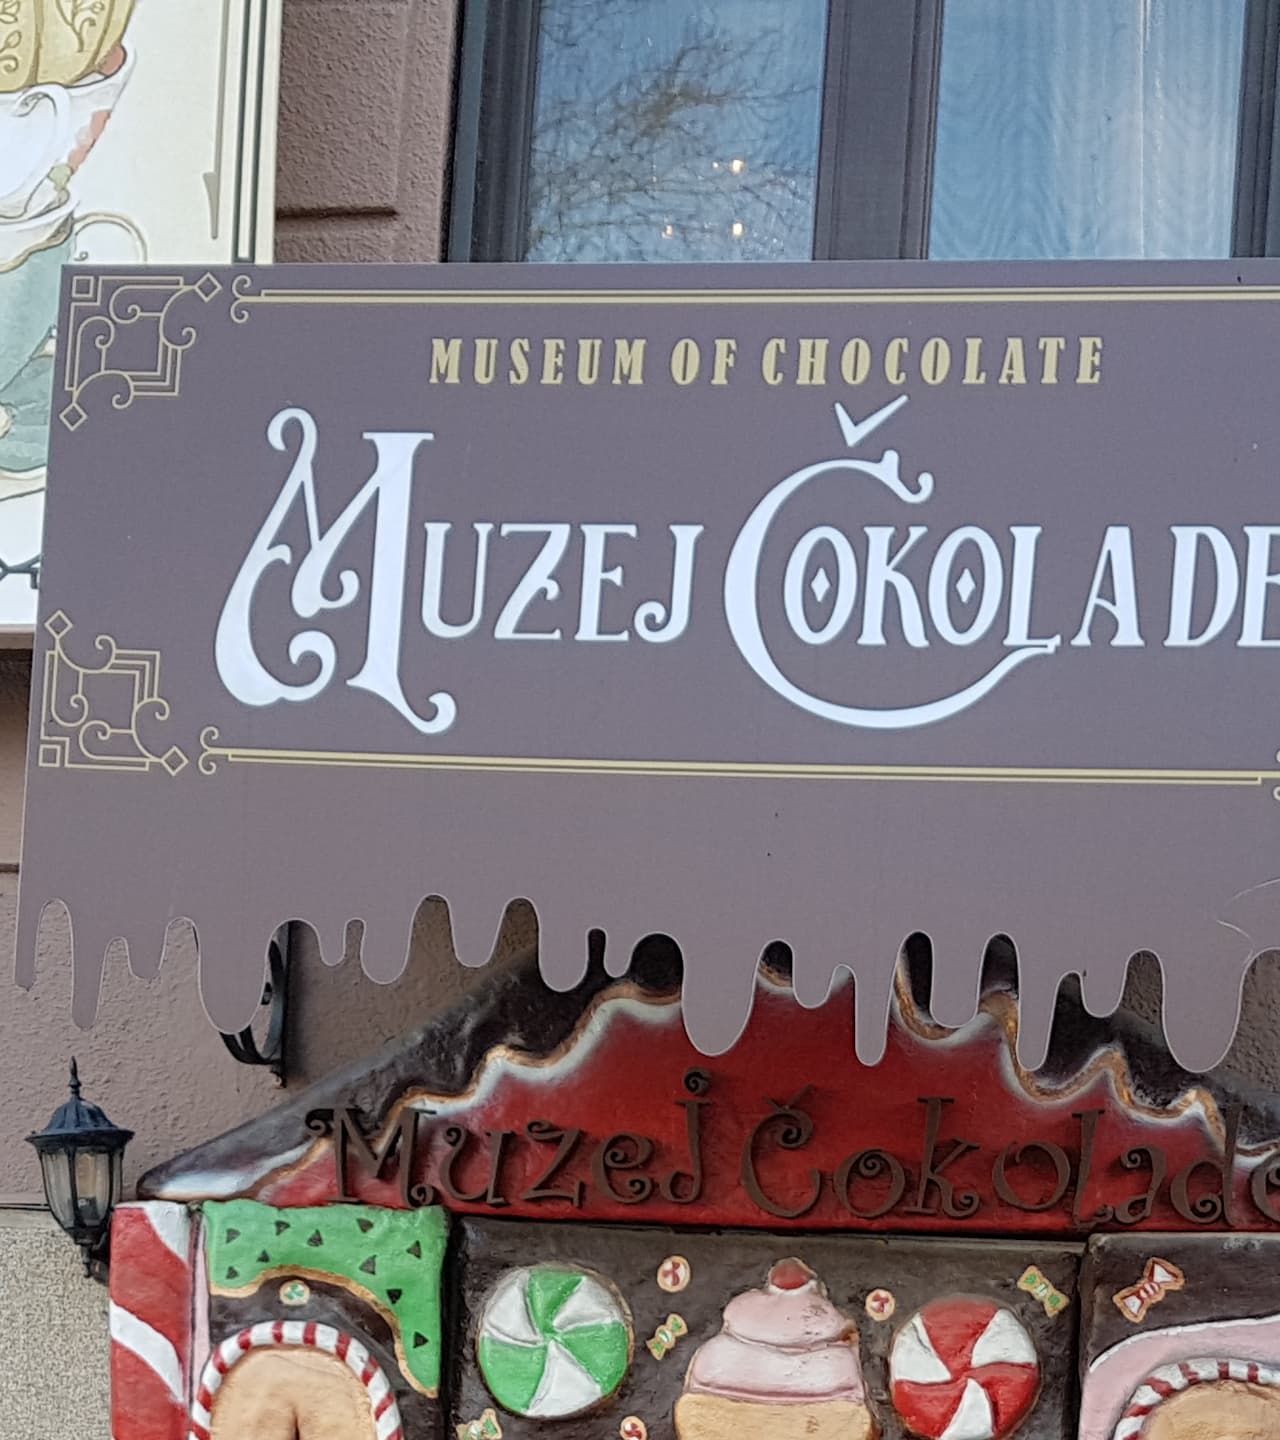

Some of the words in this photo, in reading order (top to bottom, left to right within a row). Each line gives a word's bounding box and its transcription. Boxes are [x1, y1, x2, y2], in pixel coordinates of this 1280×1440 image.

[429, 338, 644, 384] MUSEUM
[669, 338, 737, 385] OF
[761, 336, 1103, 385] CHOCOLATE
[214, 406, 704, 735] MUZEJ
[304, 1066, 714, 1208] Muzej
